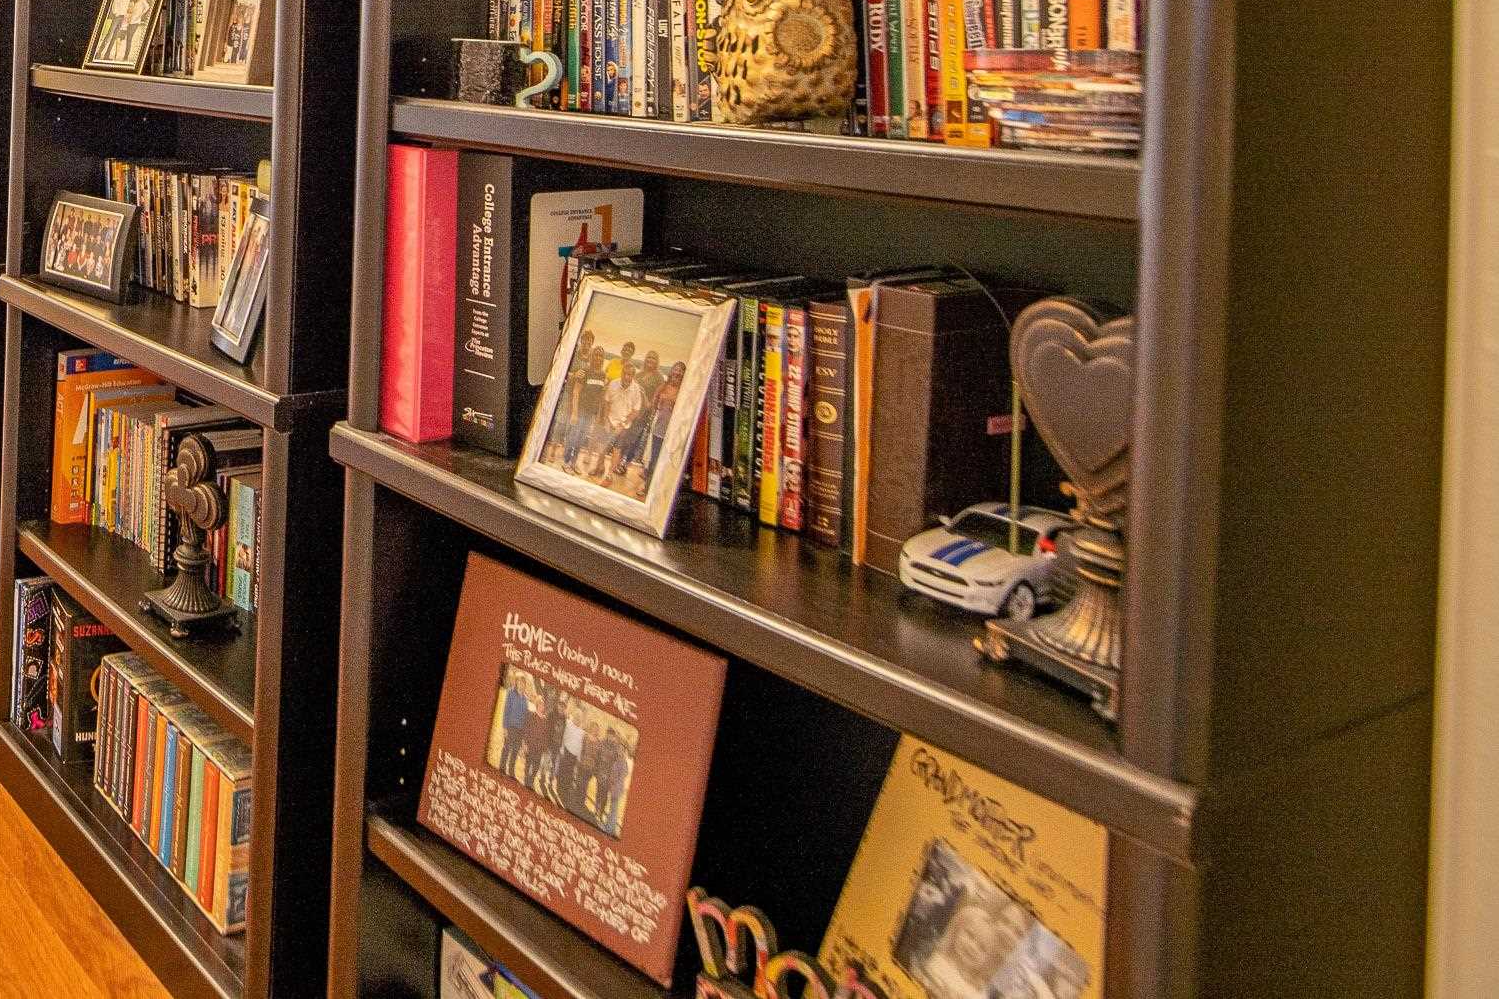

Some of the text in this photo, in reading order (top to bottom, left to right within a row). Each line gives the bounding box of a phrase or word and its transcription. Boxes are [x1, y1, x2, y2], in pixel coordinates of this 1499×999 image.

[646, 6, 655, 87] FREQUENCY
[658, 19, 668, 38] LUCY
[869, 2, 884, 53] RUDY
[1076, 26, 1088, 47] TIM
[594, 41, 602, 80] HOUSE
[469, 224, 482, 295] Advantage
[481, 184, 495, 298] College Entrance
[75, 379, 112, 391] McGraw-Hill
[785, 365, 802, 452] 22 JUMP STREET
[73, 623, 113, 637] SUZAN
[502, 611, 557, 653] HOME
[76, 732, 97, 742] HUN
